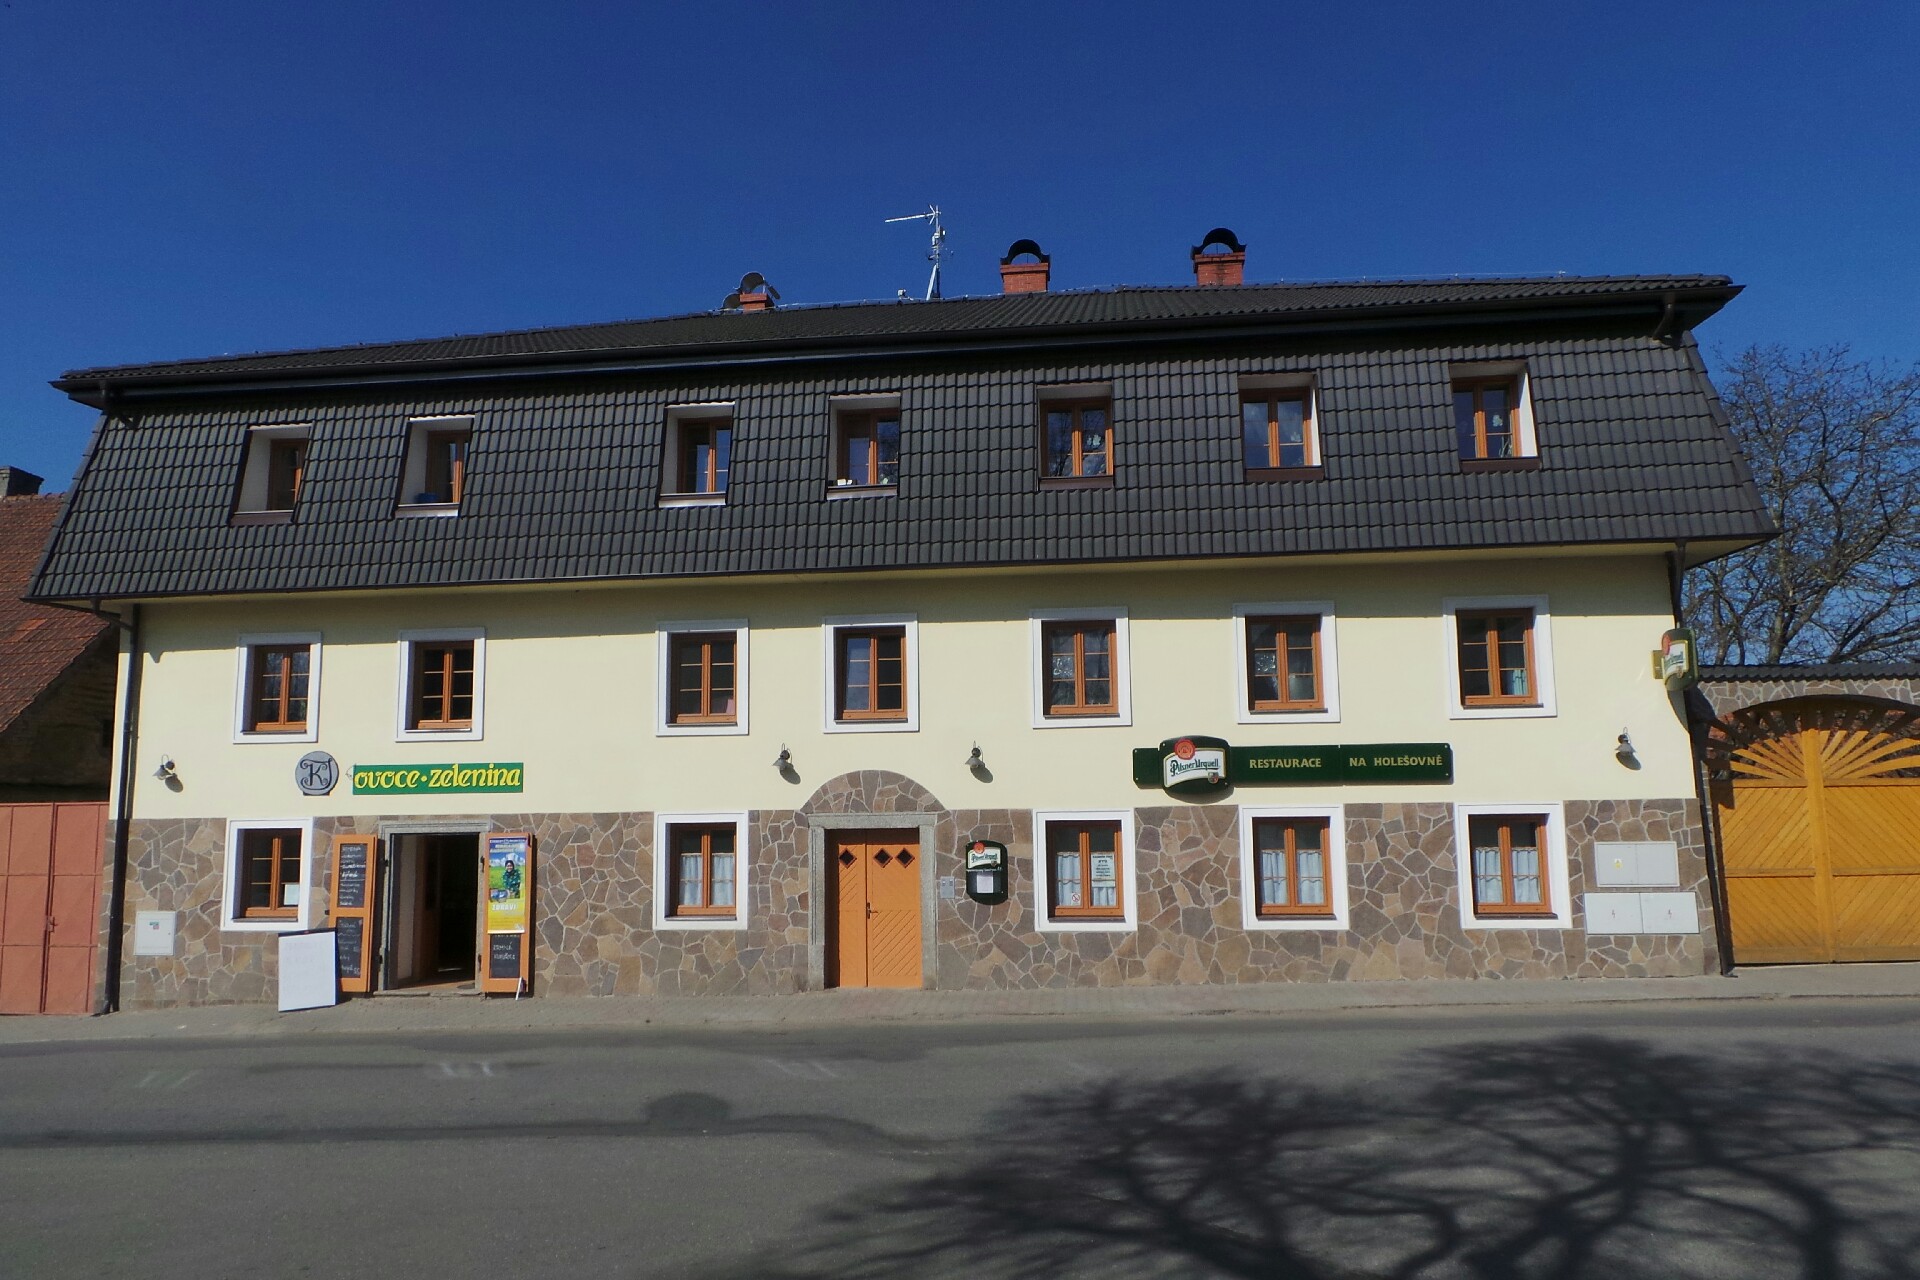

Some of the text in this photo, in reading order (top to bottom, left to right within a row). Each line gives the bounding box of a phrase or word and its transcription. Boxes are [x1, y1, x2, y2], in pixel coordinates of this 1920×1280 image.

[1170, 758, 1219, 777] Pilsner Urquell
[1249, 757, 1323, 769] RESTAURACE
[1349, 757, 1366, 768] NA
[354, 763, 521, 789] ovoce zelenina
